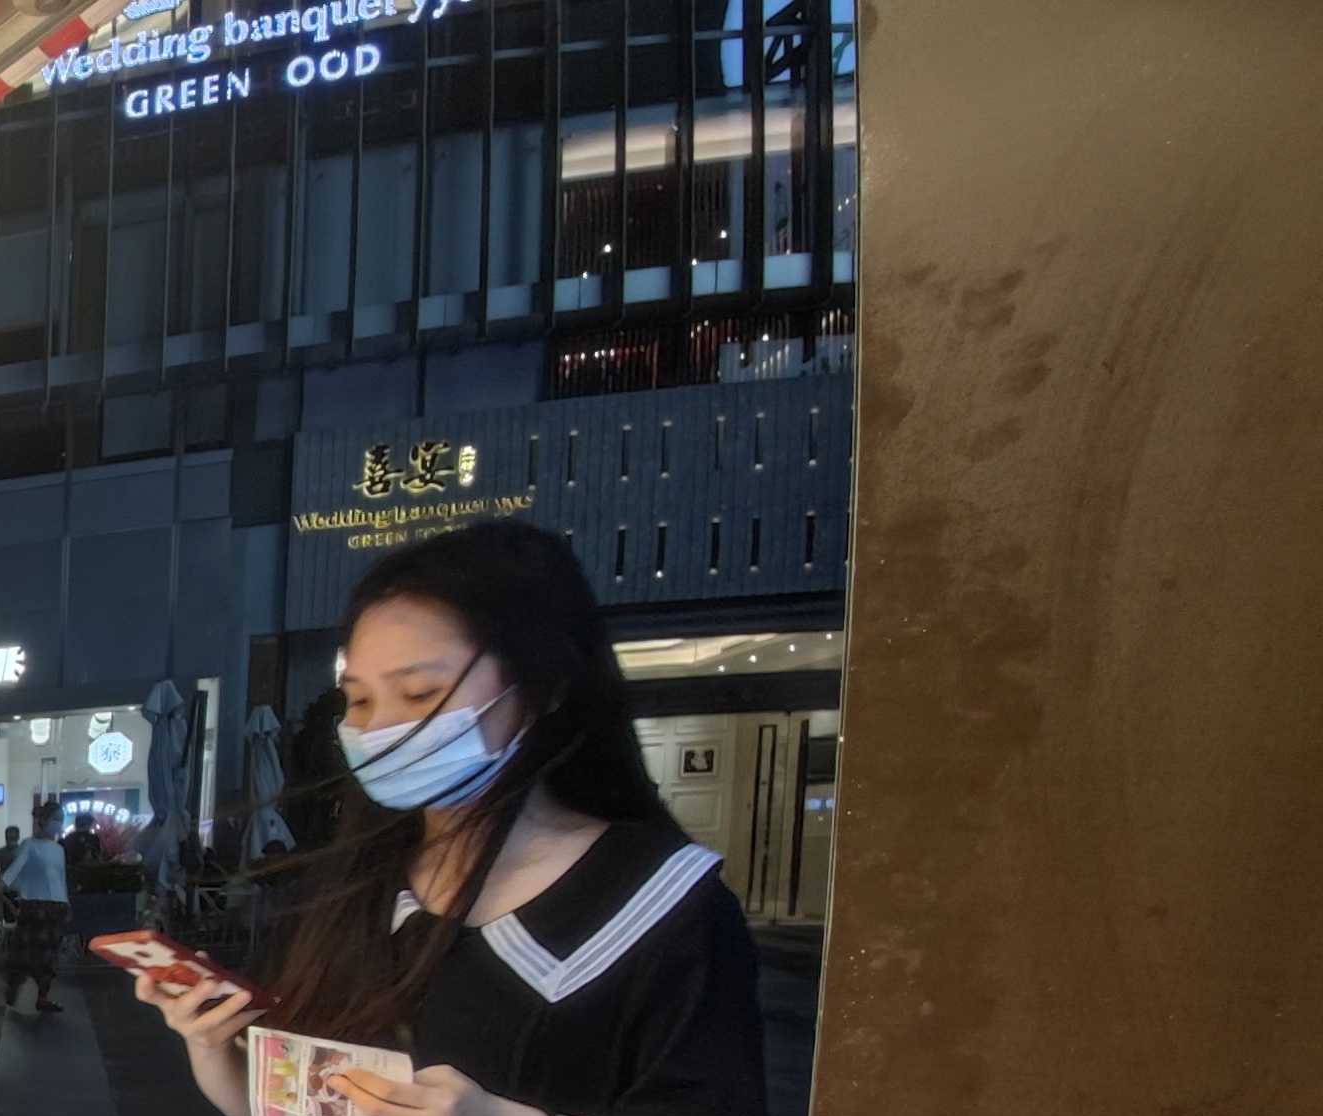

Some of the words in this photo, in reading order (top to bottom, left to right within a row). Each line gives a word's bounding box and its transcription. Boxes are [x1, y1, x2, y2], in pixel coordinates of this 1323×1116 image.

[41, 24, 214, 86] Wedding
[124, 68, 251, 119] GREEN
[292, 507, 392, 531] Wedding
[347, 530, 407, 549] GREEN
